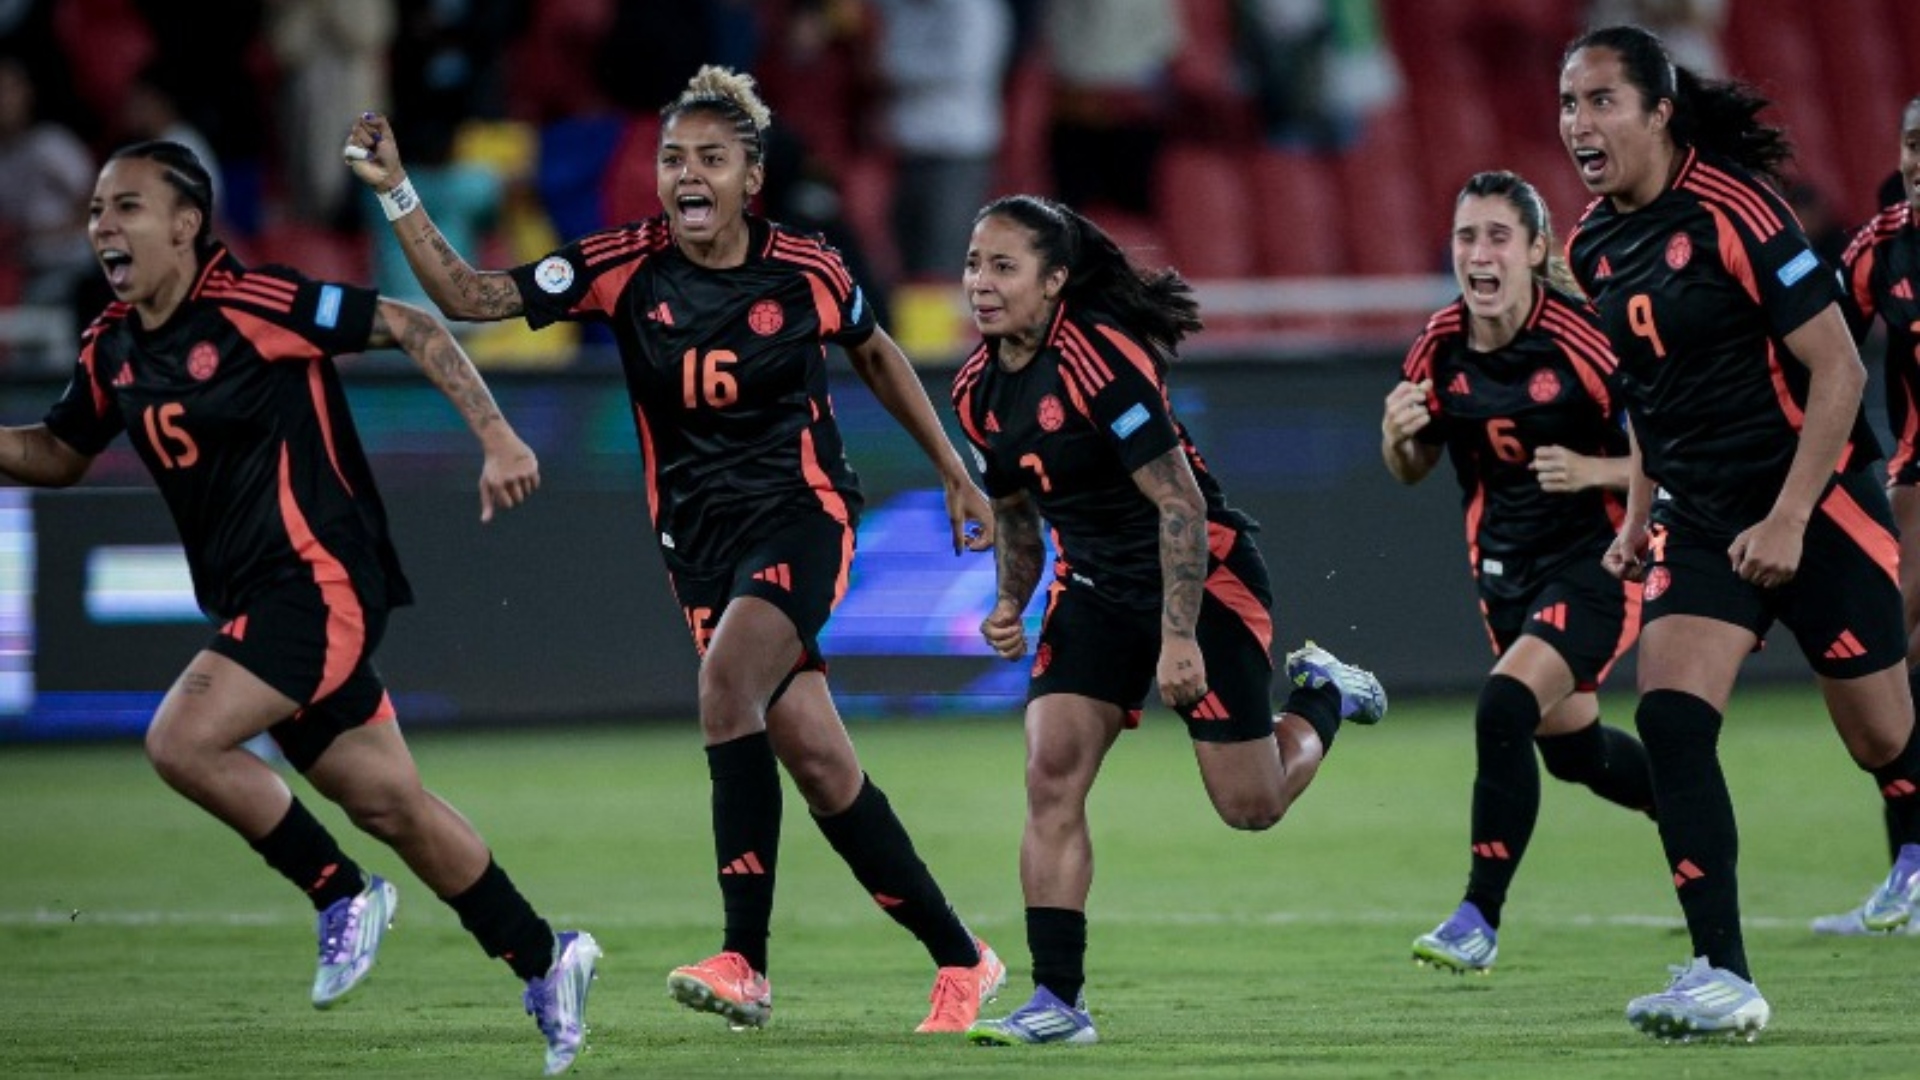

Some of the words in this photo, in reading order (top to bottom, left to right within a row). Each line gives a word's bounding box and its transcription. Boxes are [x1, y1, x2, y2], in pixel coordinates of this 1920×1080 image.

[1627, 294, 1665, 357] 9
[682, 349, 739, 408] 16
[143, 402, 199, 468] 15
[1487, 418, 1526, 462] 6
